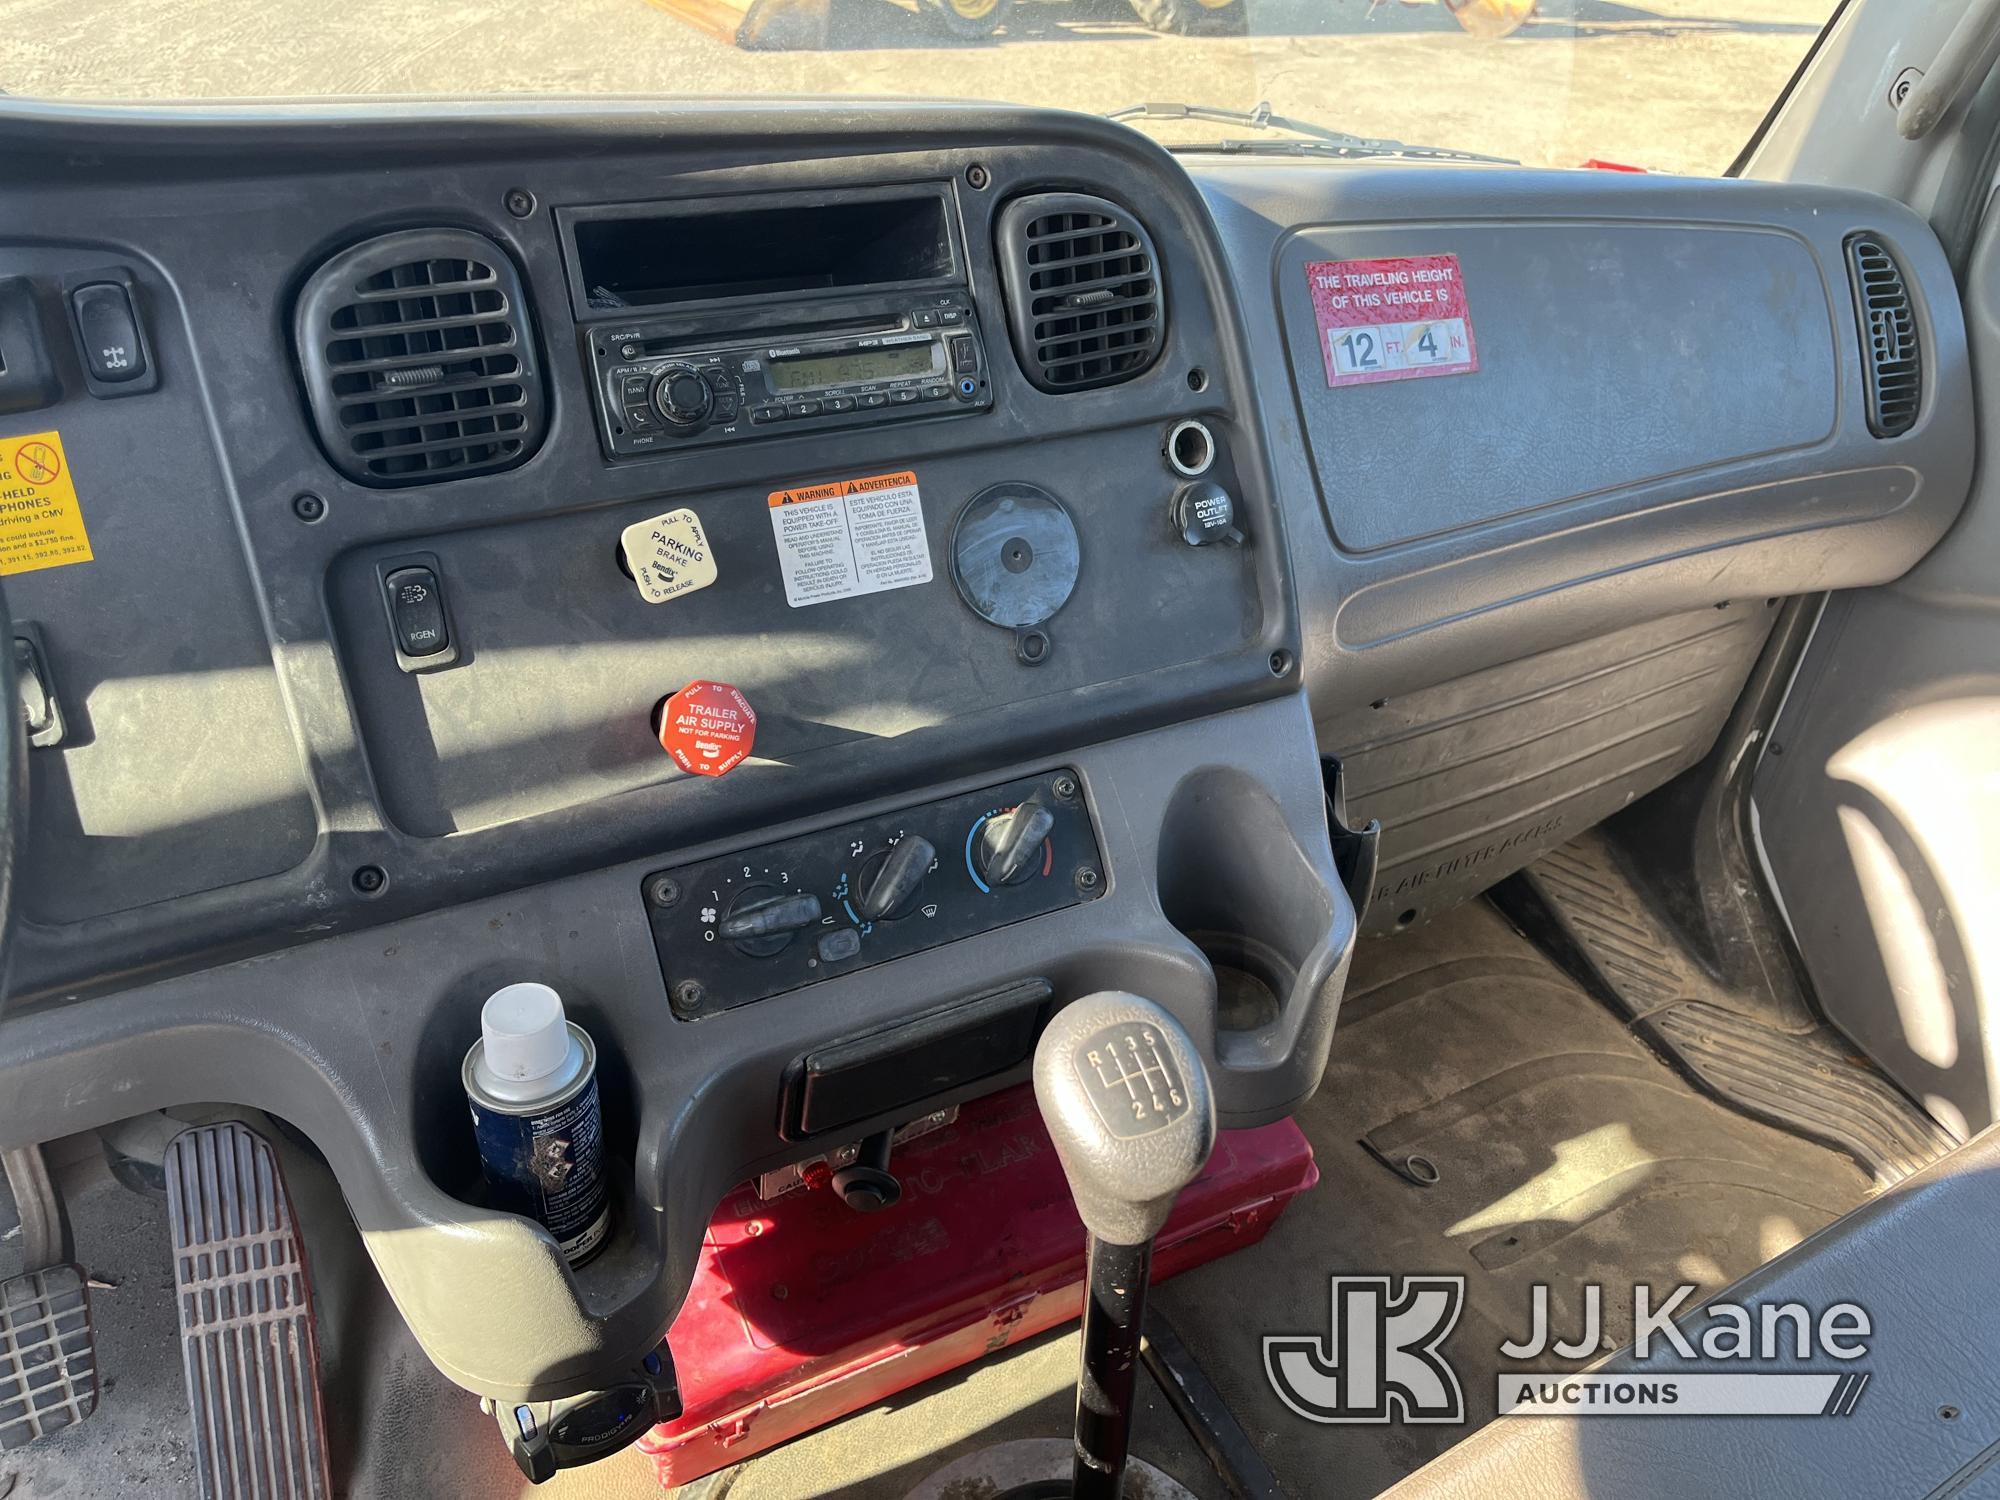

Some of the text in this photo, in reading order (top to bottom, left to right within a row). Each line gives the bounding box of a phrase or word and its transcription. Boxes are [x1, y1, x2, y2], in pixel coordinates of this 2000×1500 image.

[1315, 268, 1453, 289] THE TRAVELING HEIGHT
[1332, 288, 1448, 309] OF THIS VEHICLE IS
[858, 339, 879, 348] MP3
[1341, 332, 1378, 368] 12
[1385, 341, 1404, 354] FT.
[1418, 327, 1438, 358] 4
[860, 384, 877, 393] SCAN
[889, 380, 912, 388] REPEAT
[901, 391, 907, 400] 5
[933, 387, 939, 396] 6
[835, 400, 841, 409] 3
[868, 396, 874, 404] 4
[801, 405, 807, 414] 2
[633, 436, 654, 446] PHONE
[858, 474, 910, 491] ADVERTENCIA
[796, 487, 834, 501] WARNING
[849, 490, 912, 506] ESTE VEHICULO ESTA
[852, 502, 883, 513] EQUIPADO
[1194, 496, 1226, 510] POWER
[42, 508, 64, 519] CMV
[784, 509, 798, 517] THIS
[799, 504, 826, 514] VEHICLE
[857, 512, 876, 520] TOMA
[1197, 504, 1228, 518] OUTLET
[782, 514, 814, 525] EQUIPPED
[815, 511, 831, 519] WITH
[1204, 518, 1227, 529] 12V-10A
[661, 514, 704, 547] PULL TO APPLY
[783, 523, 807, 532] POWER
[6, 533, 27, 542] could
[29, 529, 56, 538] include
[14, 542, 27, 550] and
[651, 531, 703, 562] PARKING
[656, 547, 688, 568] BRAKE
[641, 567, 694, 597] PUSH TO RELEASE
[410, 628, 436, 641] RGEN
[684, 684, 702, 698] PULL
[730, 689, 755, 724] EVACUATE
[688, 703, 738, 720] TRAILER
[675, 714, 745, 734] AIR SUPPLY
[678, 726, 693, 734] NOT
[710, 731, 740, 742] PARKING
[675, 748, 692, 769] PUSH
[718, 750, 743, 771] SUPPLY
[743, 866, 752, 878] 2
[780, 872, 789, 884] 3
[712, 890, 719, 902] 1
[1087, 1031, 1155, 1068] R 1 3 5
[1131, 1101, 1146, 1120] 2
[1169, 1088, 1182, 1107] 6
[581, 1422, 623, 1443] PRODIGY
